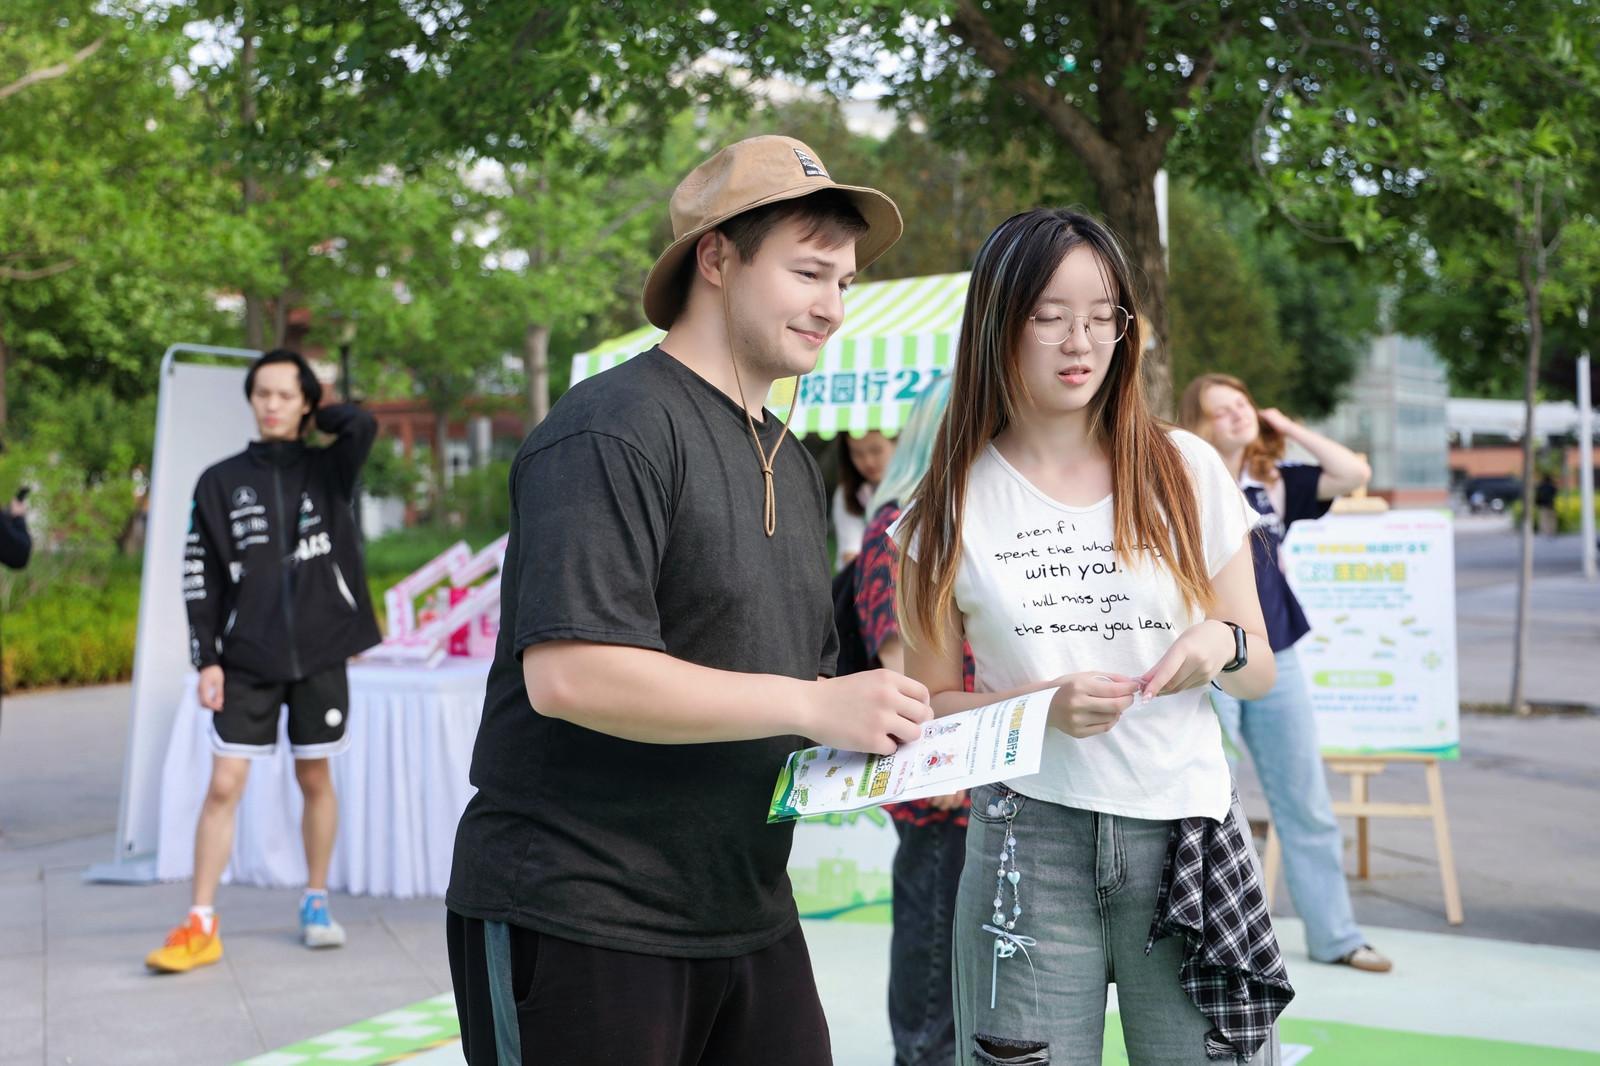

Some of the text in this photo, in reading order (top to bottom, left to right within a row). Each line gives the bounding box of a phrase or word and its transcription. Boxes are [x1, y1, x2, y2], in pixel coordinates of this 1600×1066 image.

[1016, 528, 1052, 540] even
[1056, 519, 1065, 535] if
[994, 547, 1040, 565] spent
[1047, 541, 1073, 555] the
[1082, 540, 1117, 552] whol
[1025, 561, 1123, 581] with you.
[1032, 592, 1058, 608] will
[1061, 592, 1094, 605] miss
[1100, 592, 1130, 614] you
[1014, 616, 1175, 640] the second you leav
